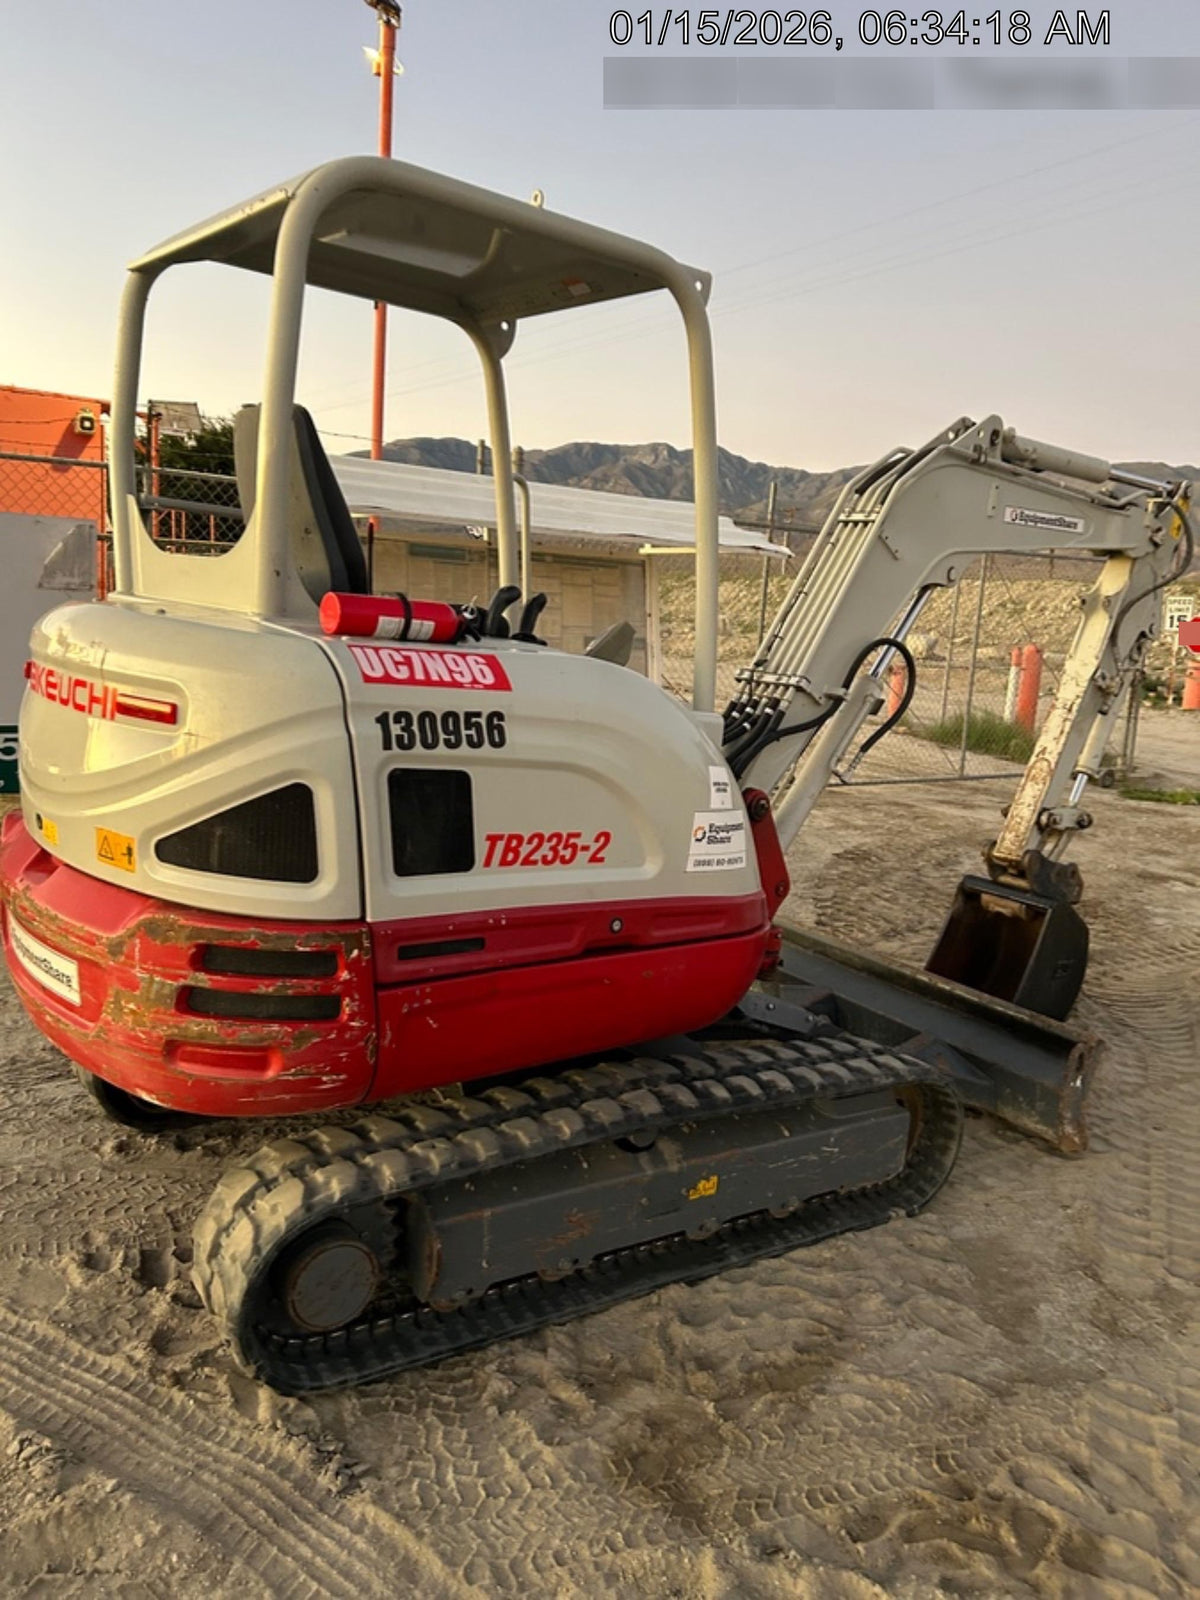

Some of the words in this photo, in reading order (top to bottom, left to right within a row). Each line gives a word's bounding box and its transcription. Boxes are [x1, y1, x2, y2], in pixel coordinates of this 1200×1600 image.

[350, 646, 496, 686] UC7N96
[374, 710, 507, 751] 130956
[482, 830, 613, 869] TB235-2
